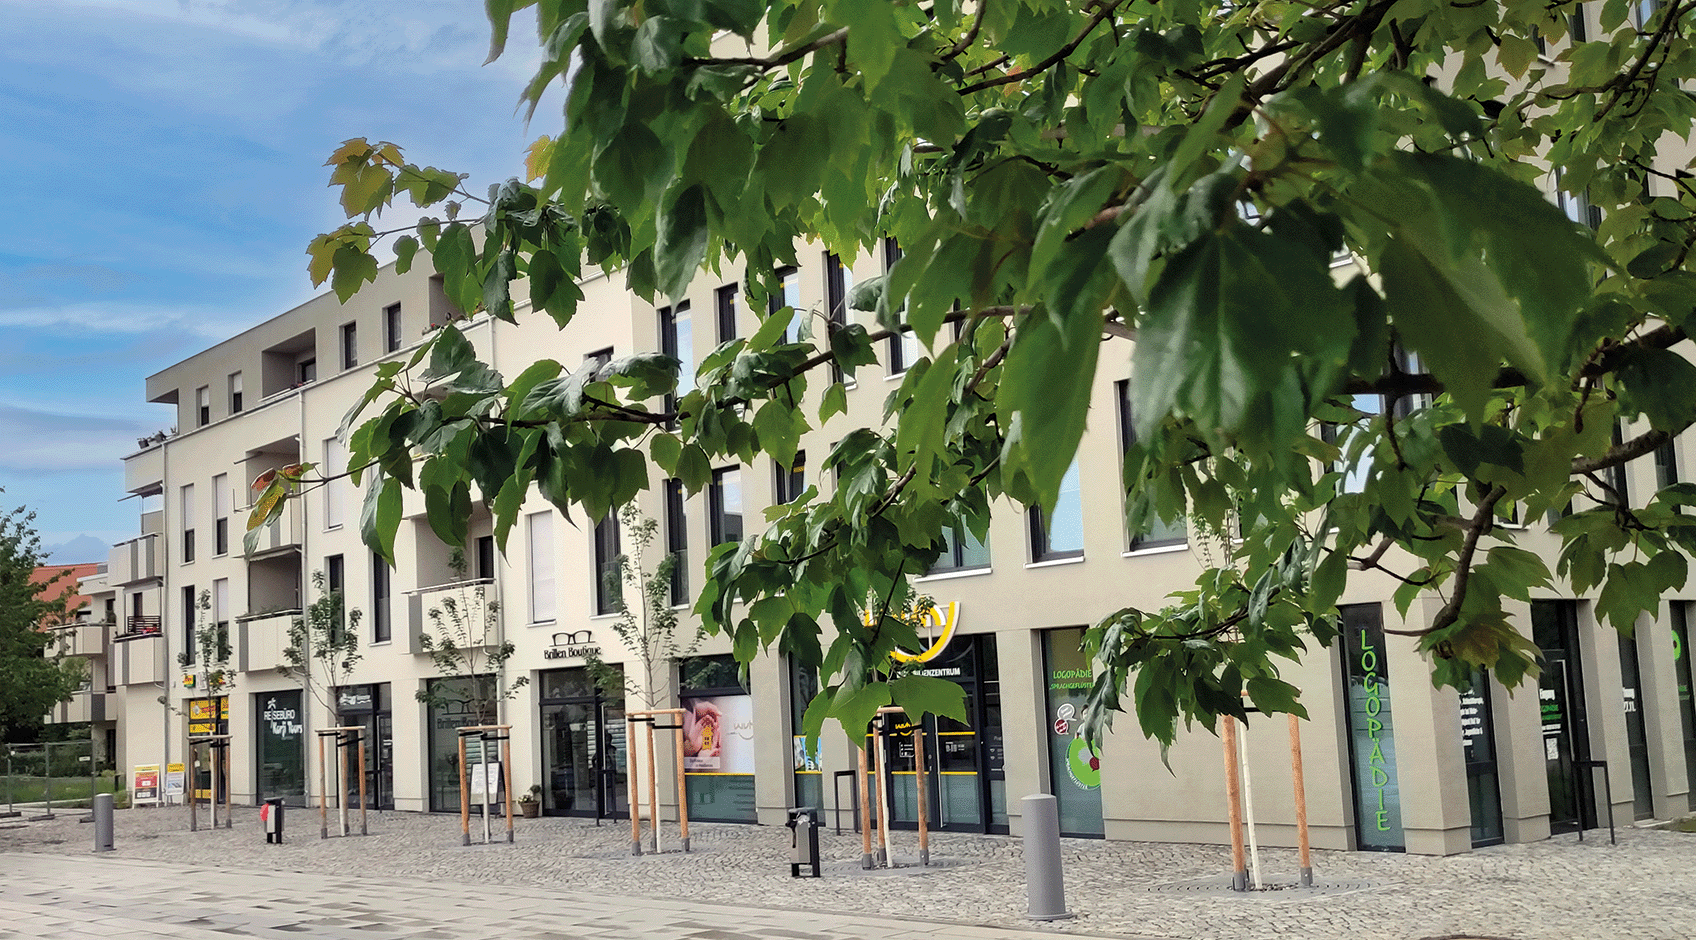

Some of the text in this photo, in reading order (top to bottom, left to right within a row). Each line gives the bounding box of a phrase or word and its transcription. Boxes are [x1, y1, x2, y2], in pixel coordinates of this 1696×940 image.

[543, 645, 602, 660] Brillen Boutique
[1053, 667, 1092, 679] LOGOPÄDIE
[1361, 629, 1391, 831] LOGOPÄDIE
